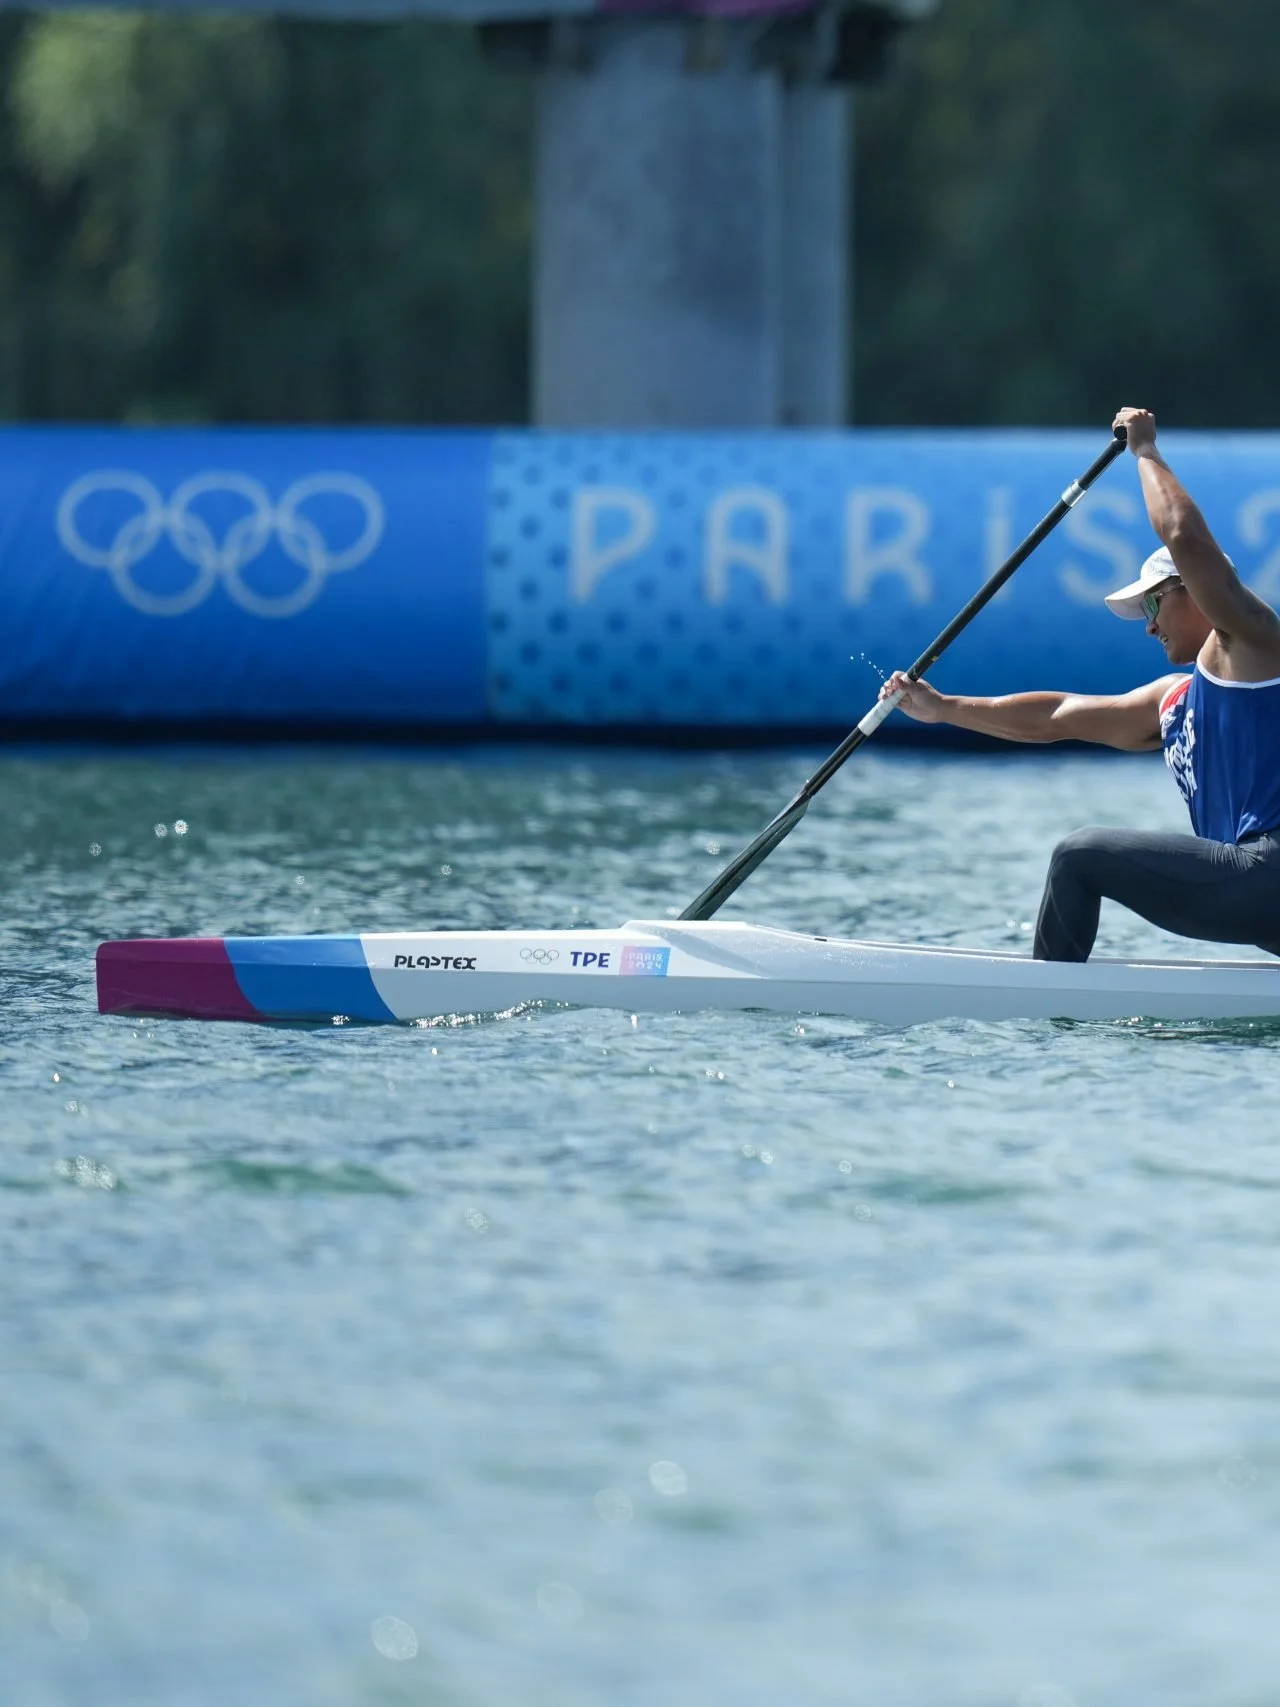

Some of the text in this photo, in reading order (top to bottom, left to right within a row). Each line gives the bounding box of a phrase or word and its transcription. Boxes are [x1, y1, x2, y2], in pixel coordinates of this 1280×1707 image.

[394, 955, 477, 970] PLASTEX
[570, 951, 611, 968] TPE
[628, 952, 663, 961] PARIS
[628, 961, 662, 970] 2024
